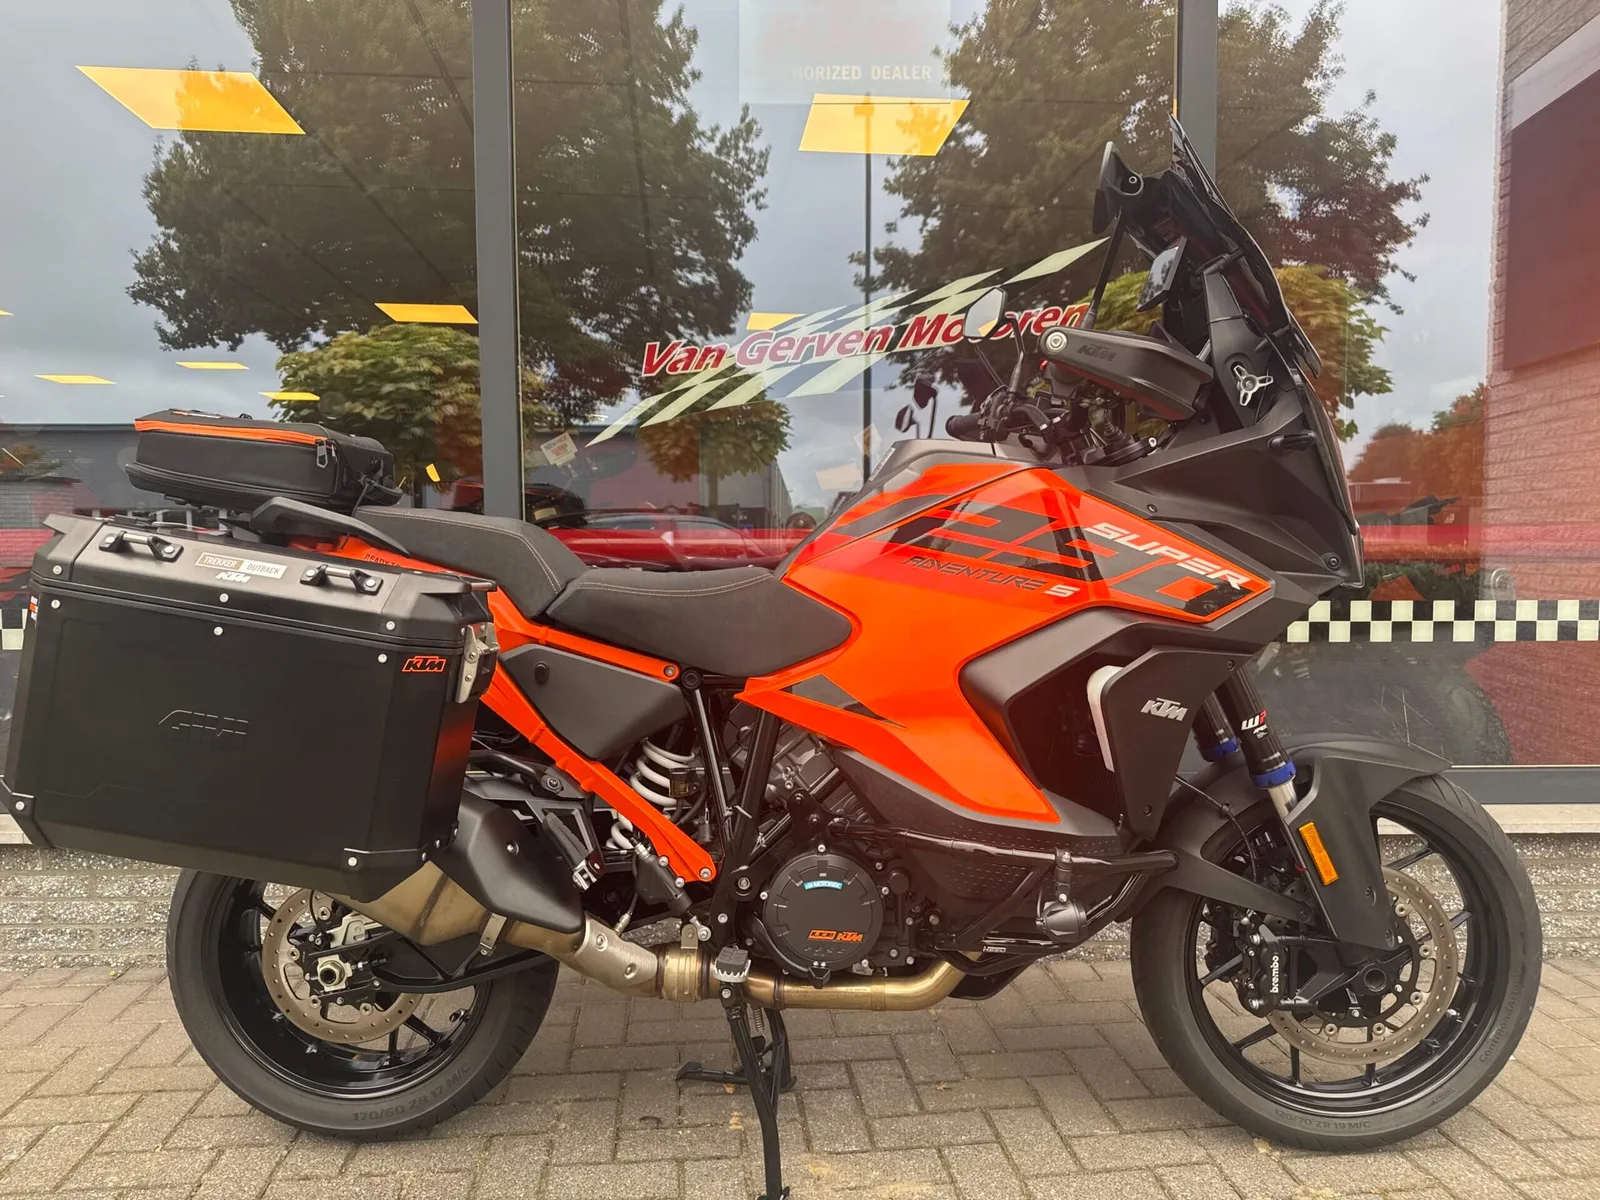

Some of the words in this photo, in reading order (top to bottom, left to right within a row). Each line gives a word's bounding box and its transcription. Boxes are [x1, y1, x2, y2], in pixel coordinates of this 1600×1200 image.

[871, 65, 932, 80] DEALER
[642, 339, 729, 377] Van
[736, 324, 896, 367] Gerven
[898, 302, 1091, 349] Mooren
[203, 556, 238, 569] TREKKER
[246, 563, 281, 575] OUTBACK
[1083, 522, 1251, 591] SUPER
[215, 571, 252, 583] KTM
[902, 555, 1048, 591] ADVENTURE
[1043, 583, 1080, 598] S
[401, 655, 447, 672] KTM
[1140, 697, 1188, 721] KTM
[836, 931, 863, 942] KTM
[1269, 955, 1279, 994] brembo
